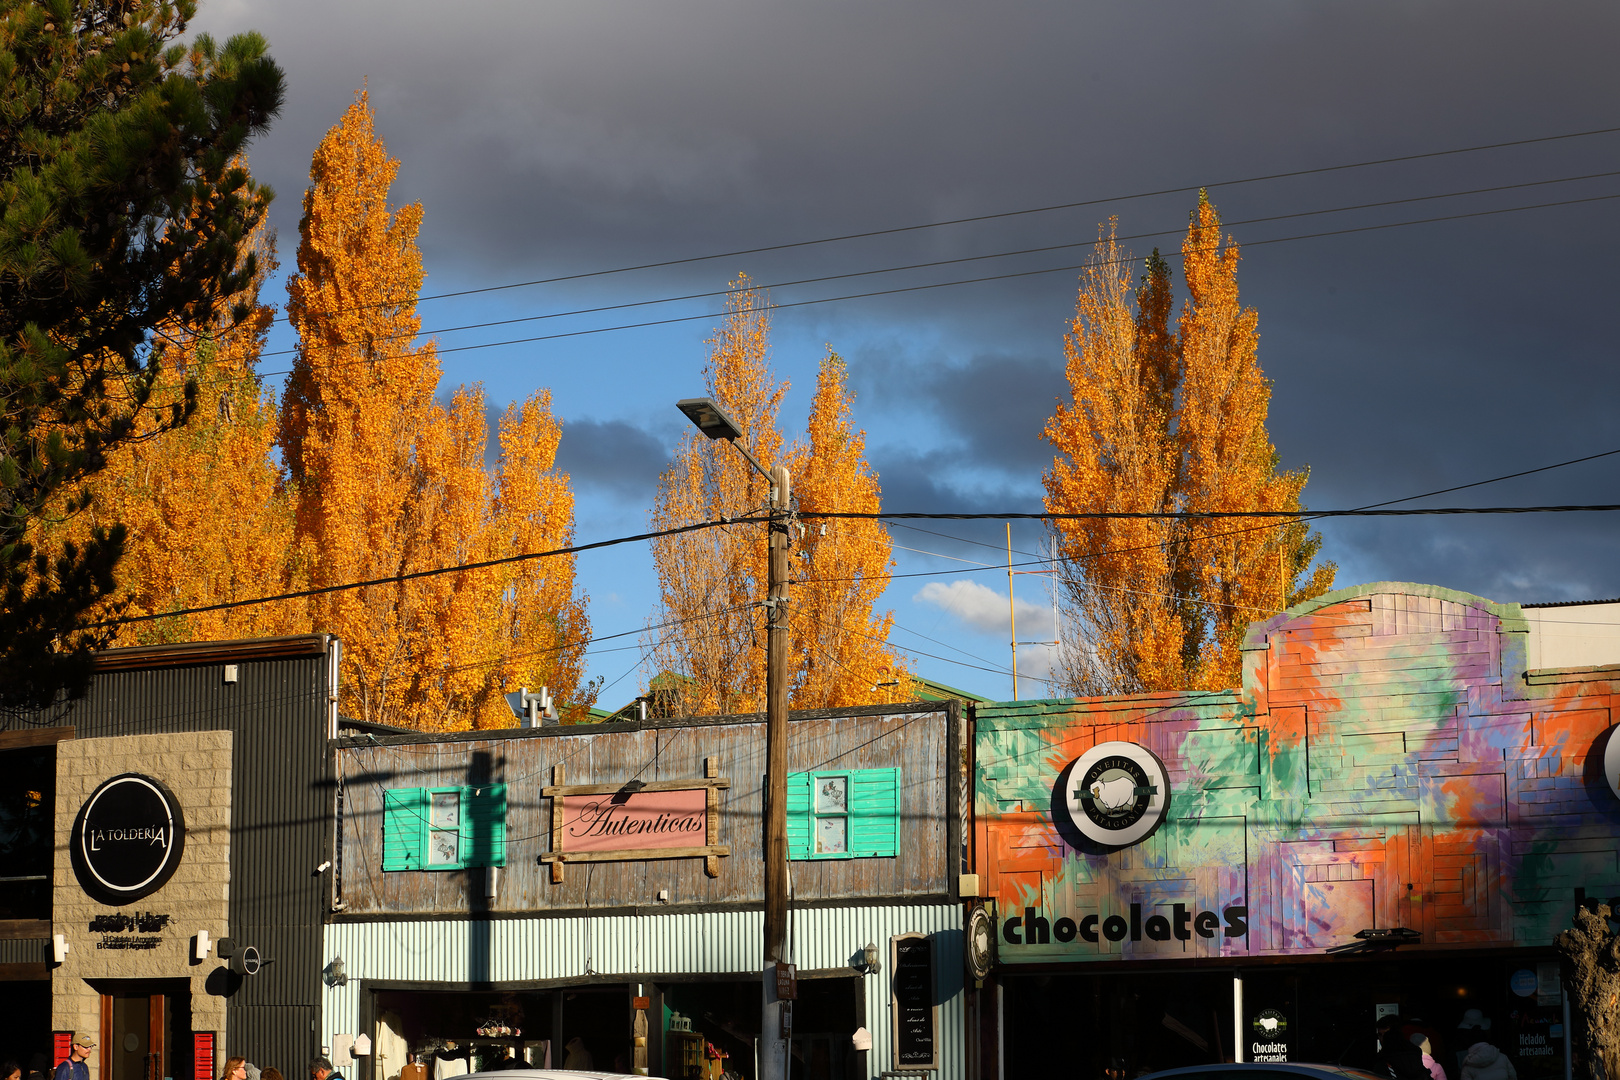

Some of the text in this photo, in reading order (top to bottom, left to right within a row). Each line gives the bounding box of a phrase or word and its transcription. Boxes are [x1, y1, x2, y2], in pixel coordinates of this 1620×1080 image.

[1090, 760, 1140, 779] OVEJITAS
[569, 801, 703, 838] Autenticas
[1089, 803, 1143, 828] PATAGONIA
[91, 824, 167, 851] LA TOLDERÍA
[1002, 903, 1248, 944] chocolates
[1252, 1041, 1287, 1054] Chocolates
[1519, 1033, 1546, 1046] Helados
[1253, 1052, 1287, 1063] artesanales
[1519, 1044, 1554, 1056] artesanales
